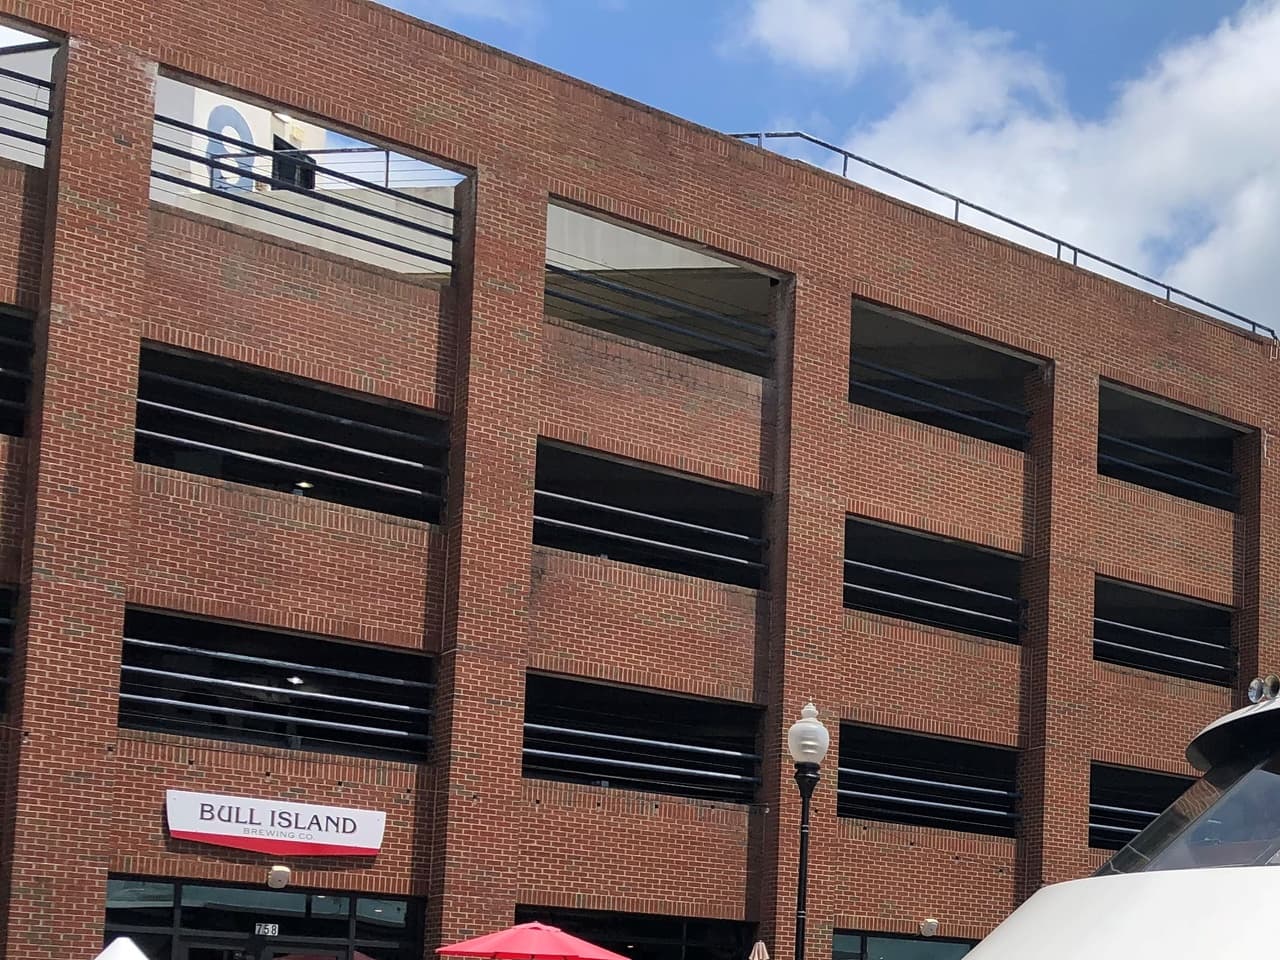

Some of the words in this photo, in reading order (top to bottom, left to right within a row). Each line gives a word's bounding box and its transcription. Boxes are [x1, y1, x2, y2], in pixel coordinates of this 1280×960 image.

[199, 802, 262, 826] BULL
[270, 810, 357, 834] ISLAND
[243, 827, 295, 840] BREWING
[256, 923, 278, 936] 758
